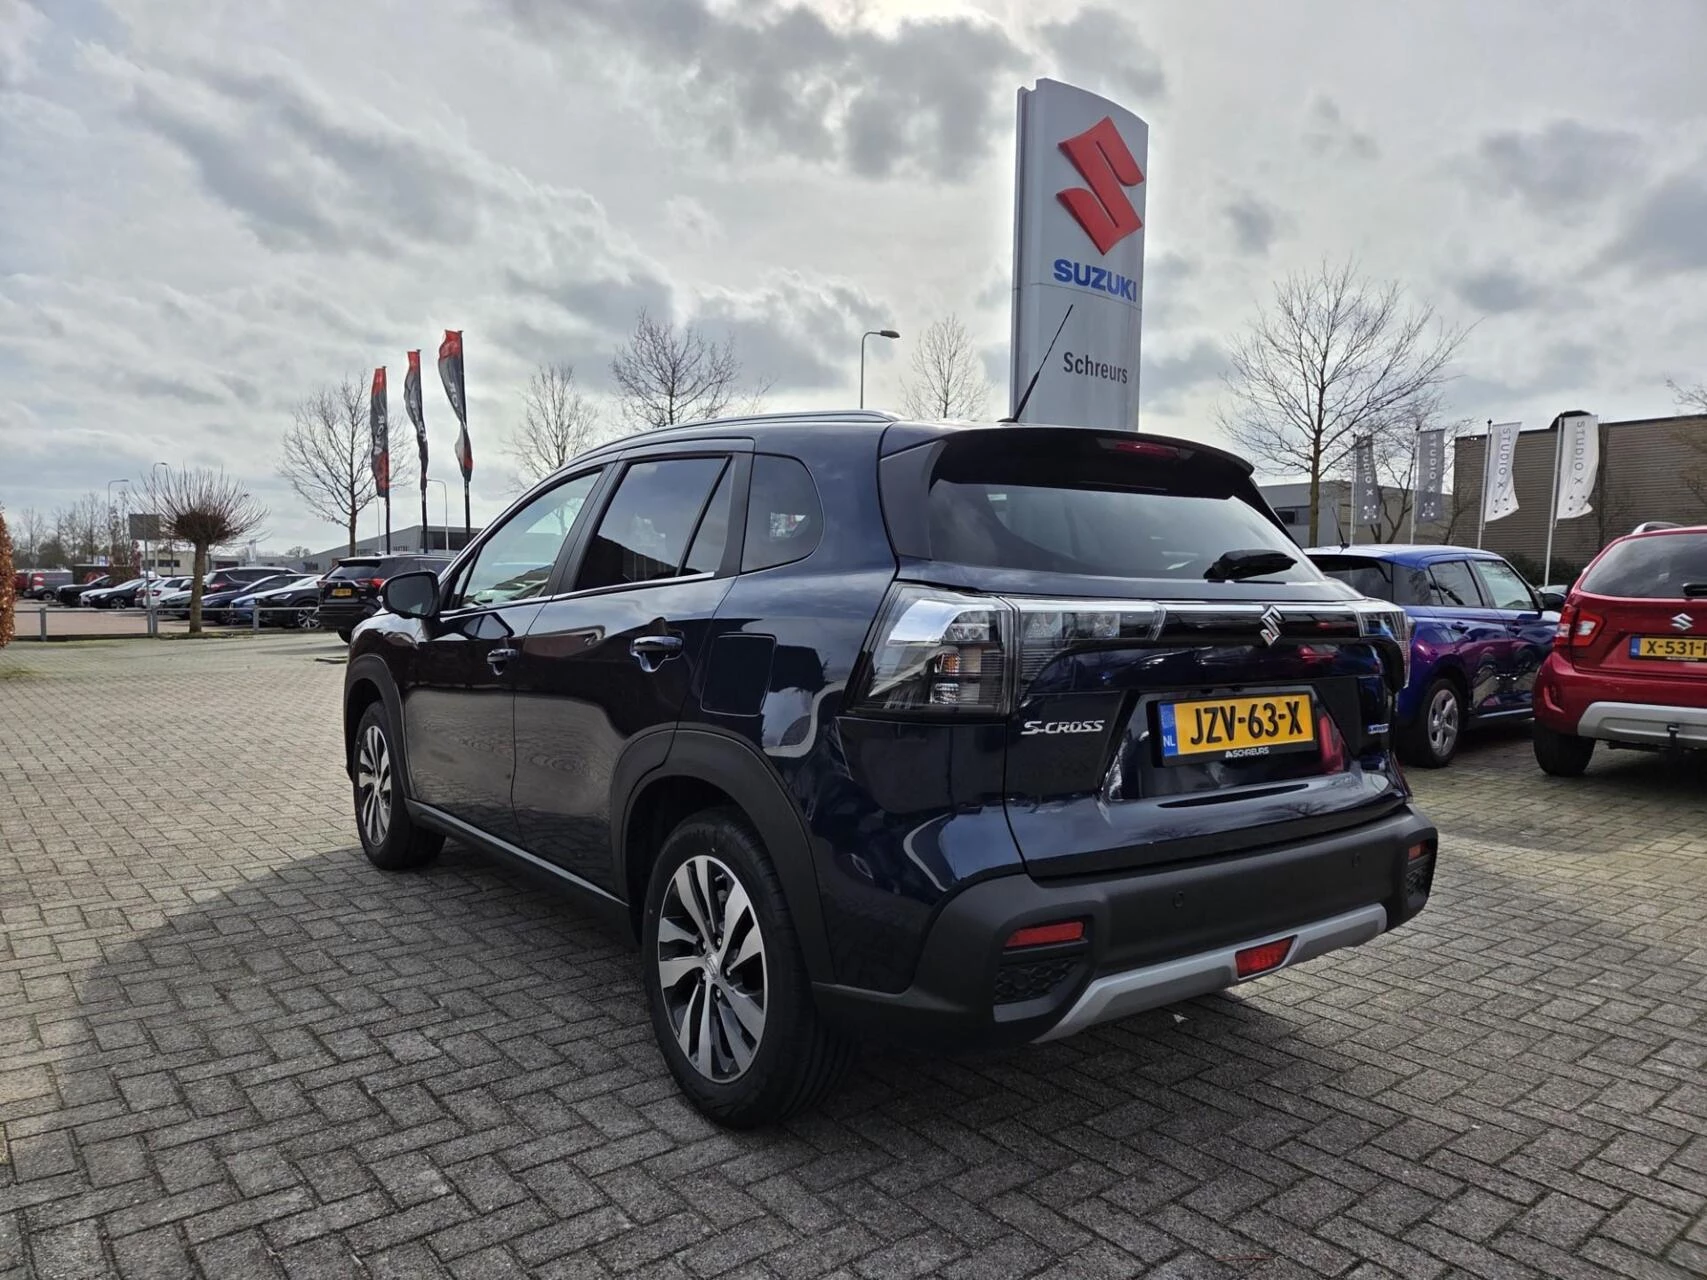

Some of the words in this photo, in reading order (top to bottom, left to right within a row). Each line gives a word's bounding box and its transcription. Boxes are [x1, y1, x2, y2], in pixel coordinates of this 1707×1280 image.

[1053, 258, 1137, 302] SUZUKI
[1063, 351, 1128, 384] Schreurs
[1429, 433, 1437, 480] STUDIO
[1498, 427, 1511, 476] STUDIO
[1574, 420, 1585, 471] STUDIO
[1366, 488, 1374, 496] X
[1427, 485, 1435, 493] X
[1497, 481, 1505, 489] X
[1574, 477, 1583, 485] X
[1190, 701, 1303, 745] JZV-63-X
[1162, 735, 1176, 747] NL
